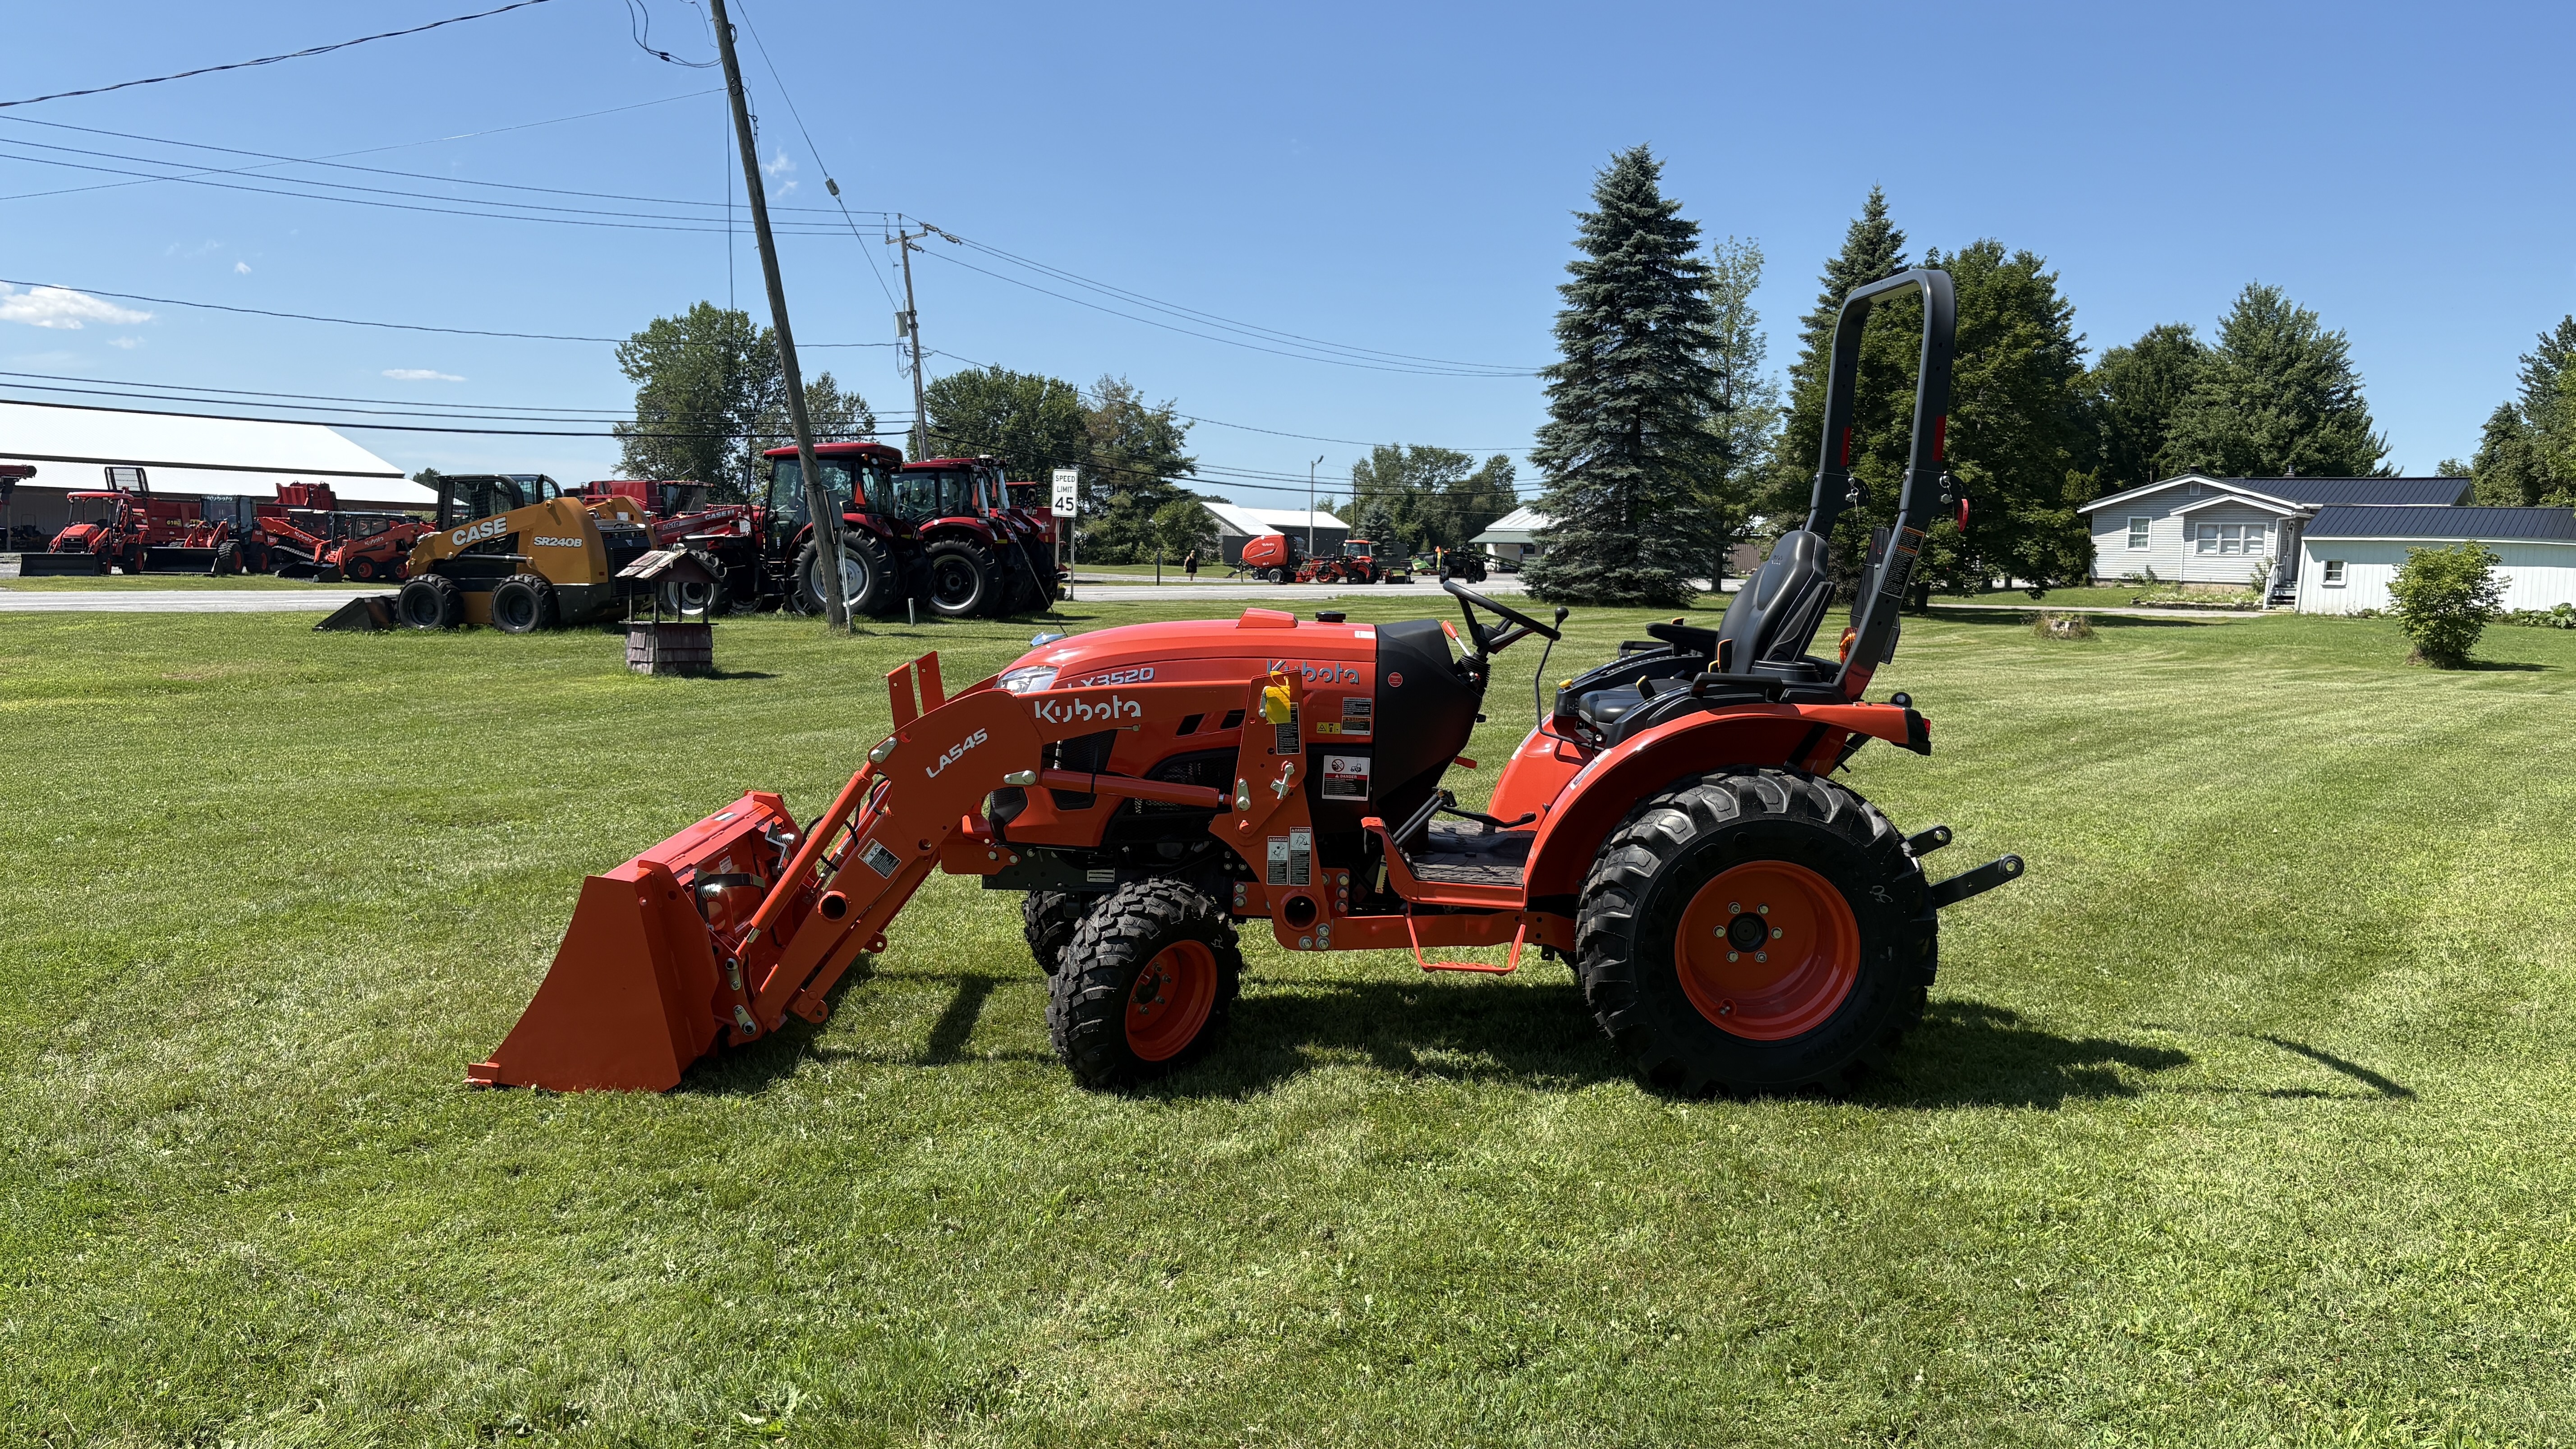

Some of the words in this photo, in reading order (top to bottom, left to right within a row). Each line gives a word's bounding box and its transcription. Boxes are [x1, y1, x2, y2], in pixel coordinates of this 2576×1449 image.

[1055, 496, 1074, 511] 45
[452, 517, 507, 546] CASE
[534, 536, 582, 547] SR240B
[1266, 659, 1359, 683] Kbota
[1034, 695, 1141, 723] Kubota
[926, 728, 988, 778] LA545
